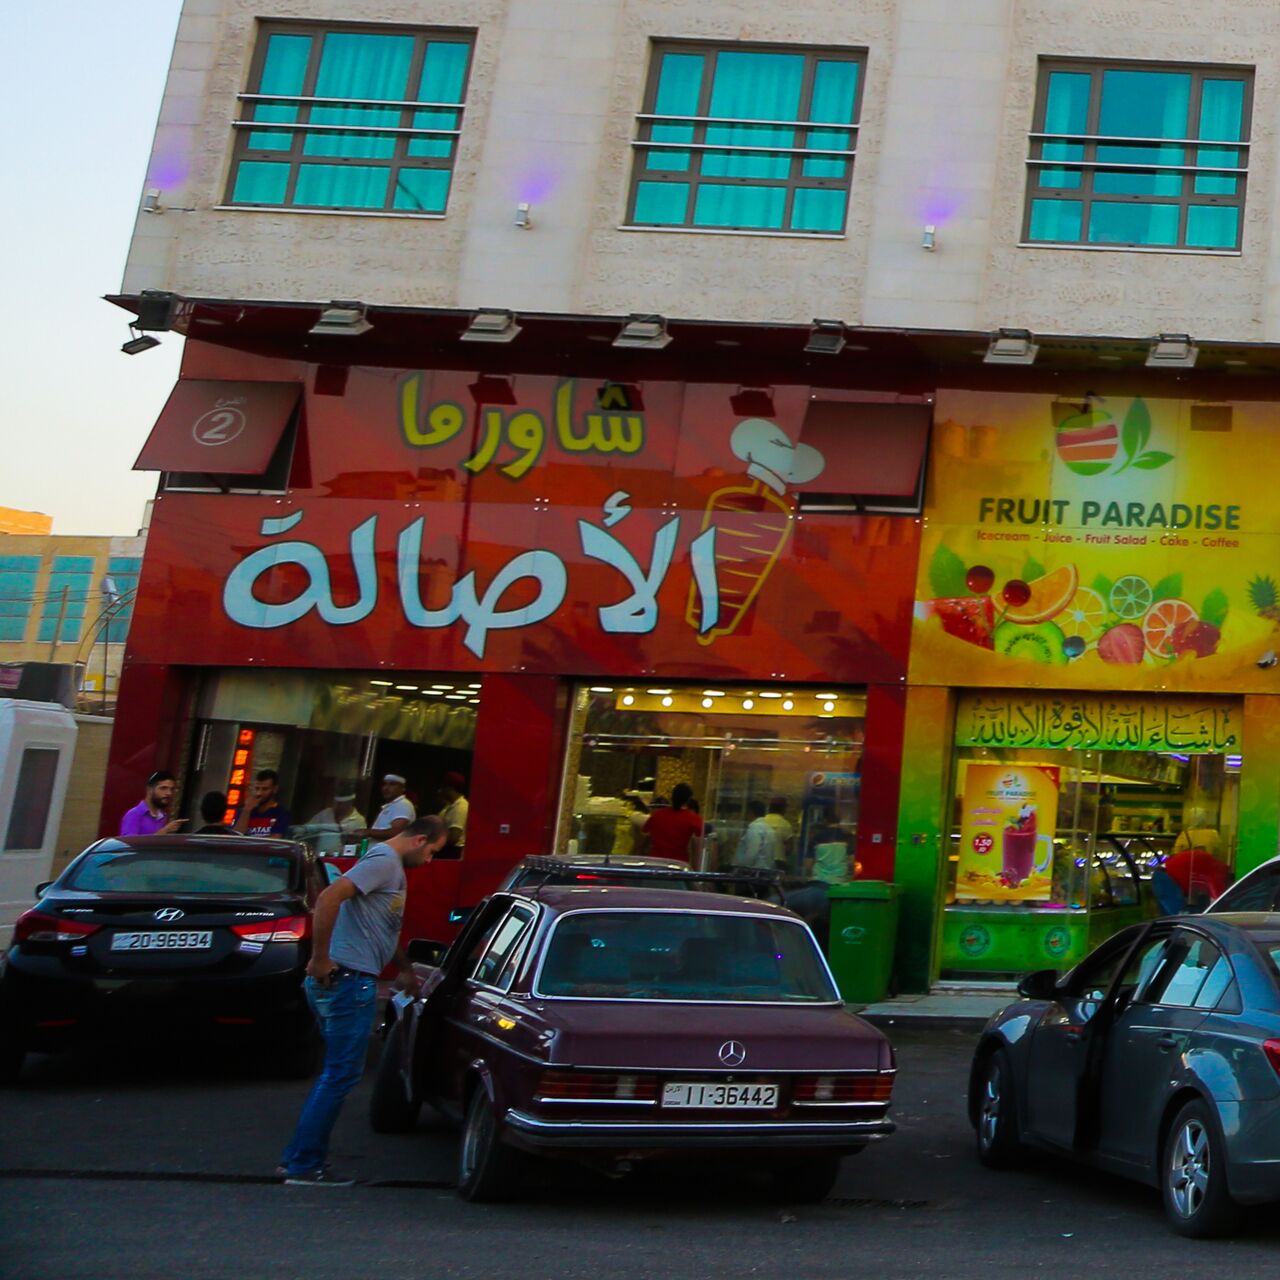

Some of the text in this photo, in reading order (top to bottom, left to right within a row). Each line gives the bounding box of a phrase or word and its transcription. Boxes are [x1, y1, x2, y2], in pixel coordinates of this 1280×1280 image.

[202, 412, 236, 439] 2
[400, 373, 645, 478] شاورما
[978, 497, 1241, 531] FRUIT PARADISE
[977, 531, 1240, 549] Icecream Juice Fruit Salad Cake Coffee
[222, 490, 719, 661] الأصالة
[129, 932, 210, 949] 20-96934
[686, 1085, 776, 1106] 11-36442
